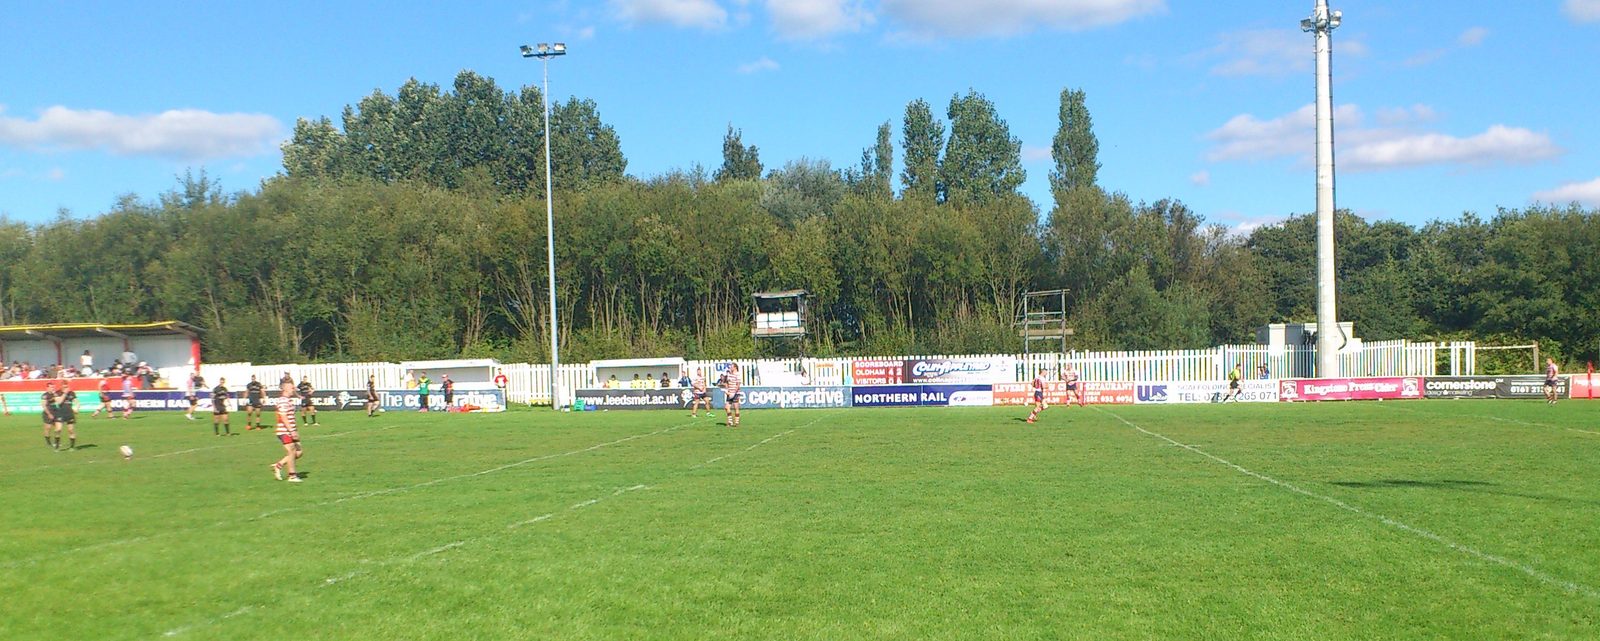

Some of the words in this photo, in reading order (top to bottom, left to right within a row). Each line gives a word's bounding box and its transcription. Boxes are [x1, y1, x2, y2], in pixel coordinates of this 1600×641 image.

[1426, 380, 1496, 390] cornerstone
[1510, 385, 1529, 393] 0161
[377, 391, 402, 407] The
[577, 393, 679, 405] www.leedsmet.ac.uk
[854, 393, 917, 403] NORTHERN
[921, 392, 947, 402] RAIL
[1259, 391, 1277, 400] 071
